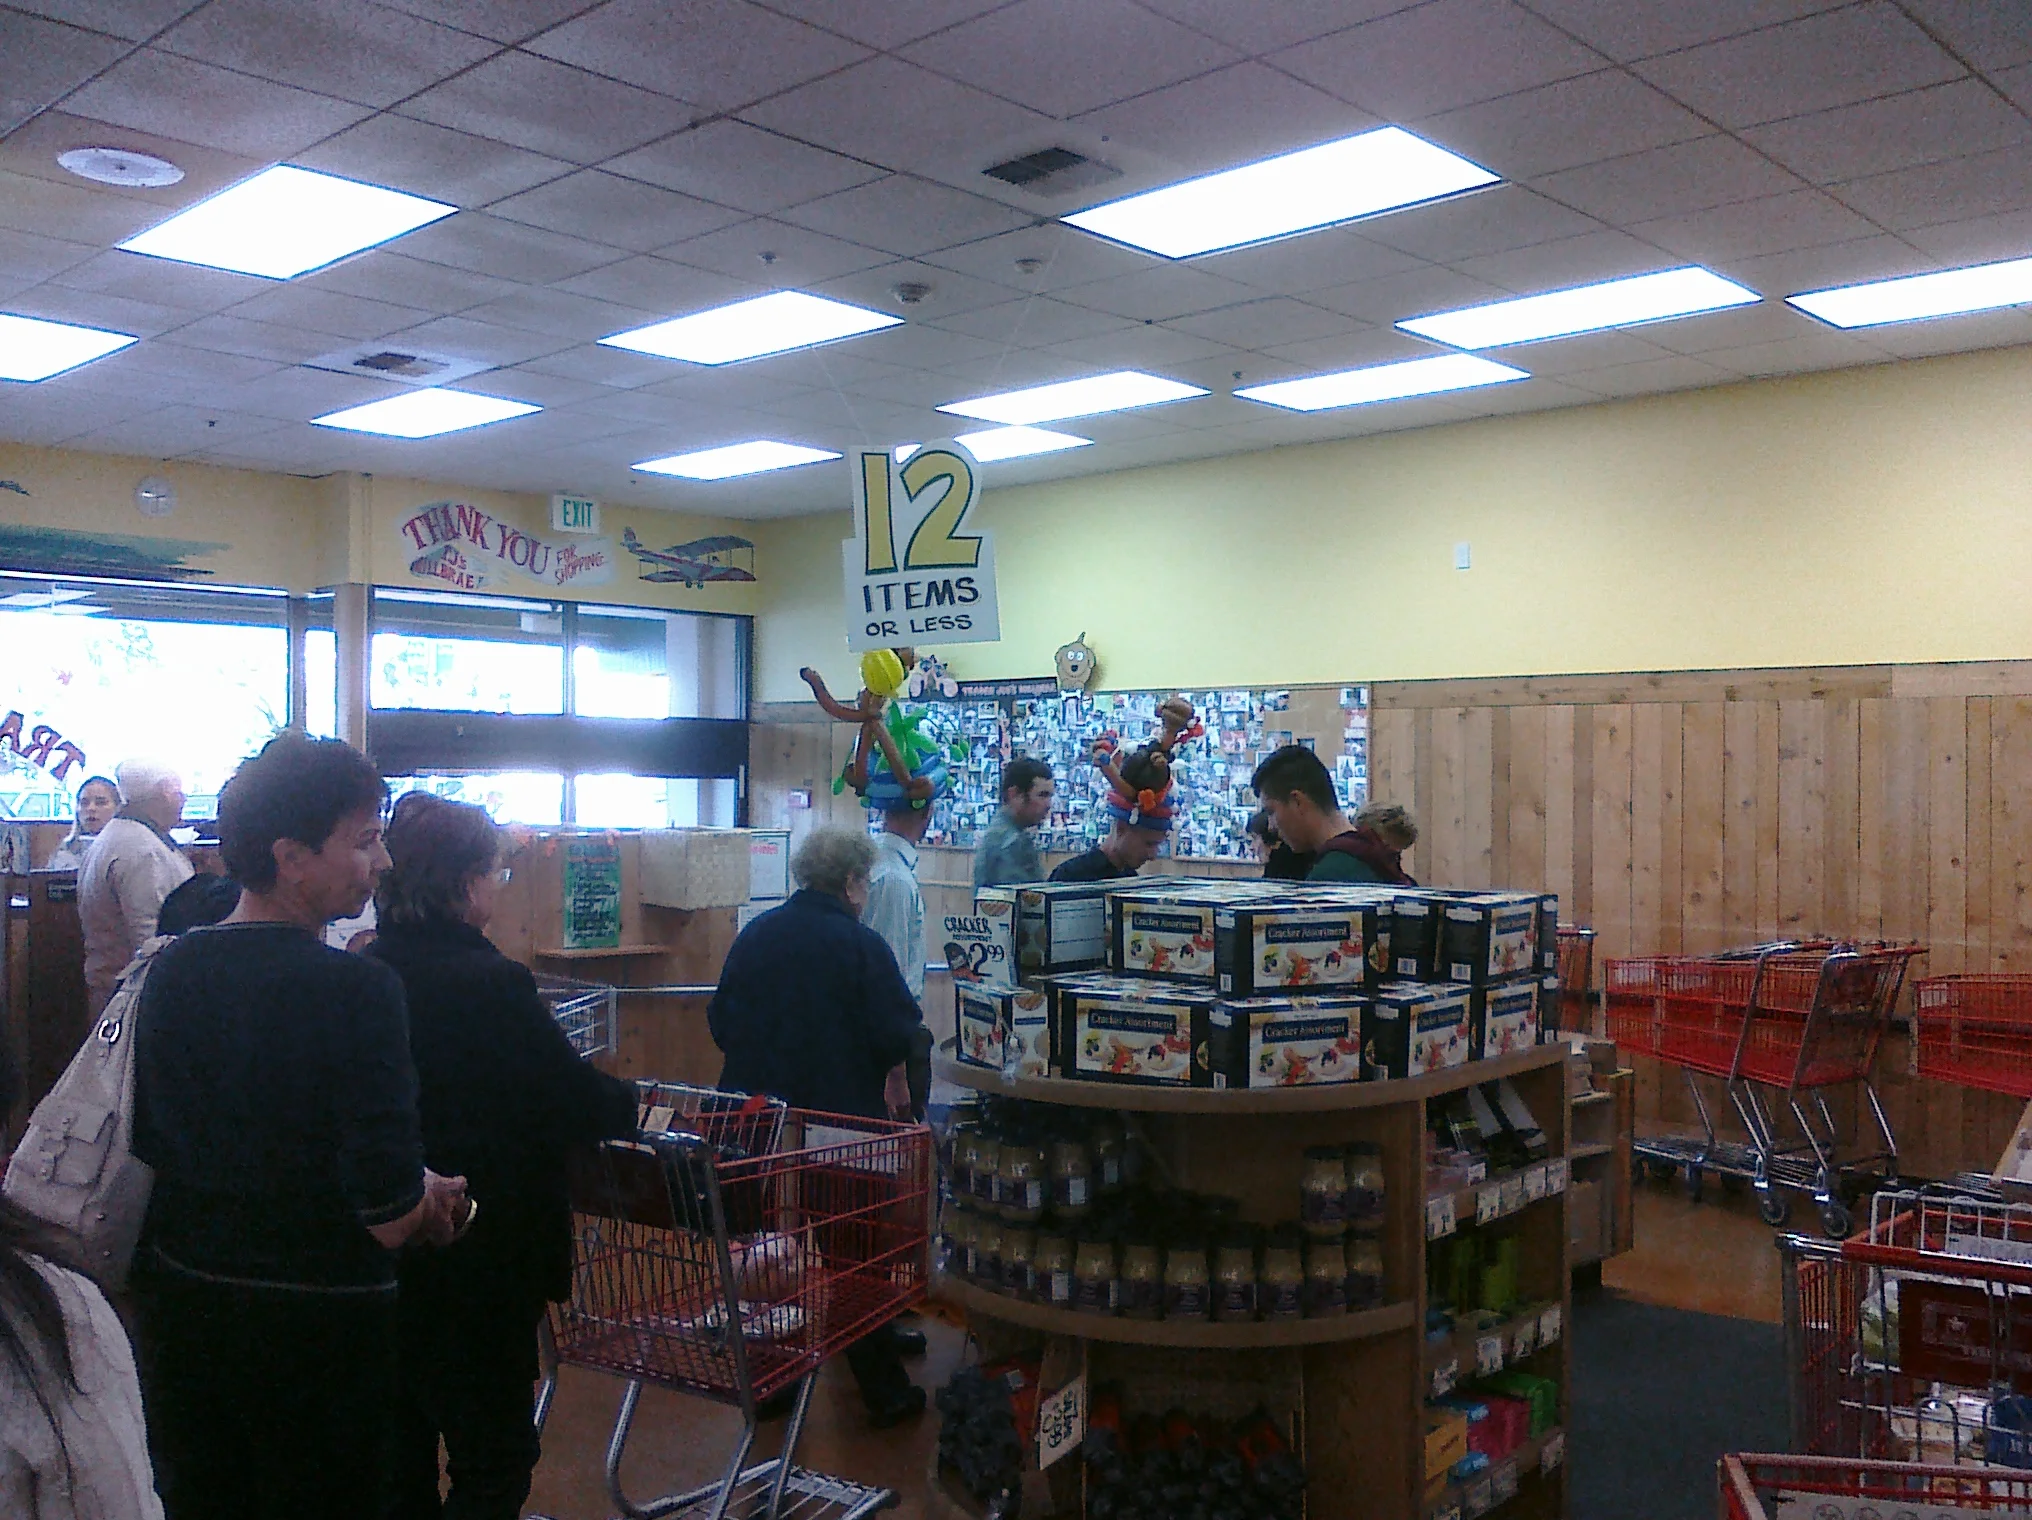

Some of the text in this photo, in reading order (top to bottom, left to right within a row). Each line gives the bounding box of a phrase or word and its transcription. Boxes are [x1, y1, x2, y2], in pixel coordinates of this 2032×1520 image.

[563, 499, 594, 528] EXIT
[861, 450, 983, 576] 12
[402, 503, 552, 575] THANK YOU
[555, 551, 604, 586] SHOPPING
[863, 576, 980, 613] ITEMS
[865, 614, 973, 638] OR LESS
[944, 916, 993, 935] CRACKER
[1091, 1012, 1123, 1026] Cracker
[1264, 1025, 1298, 1039] Cracker
